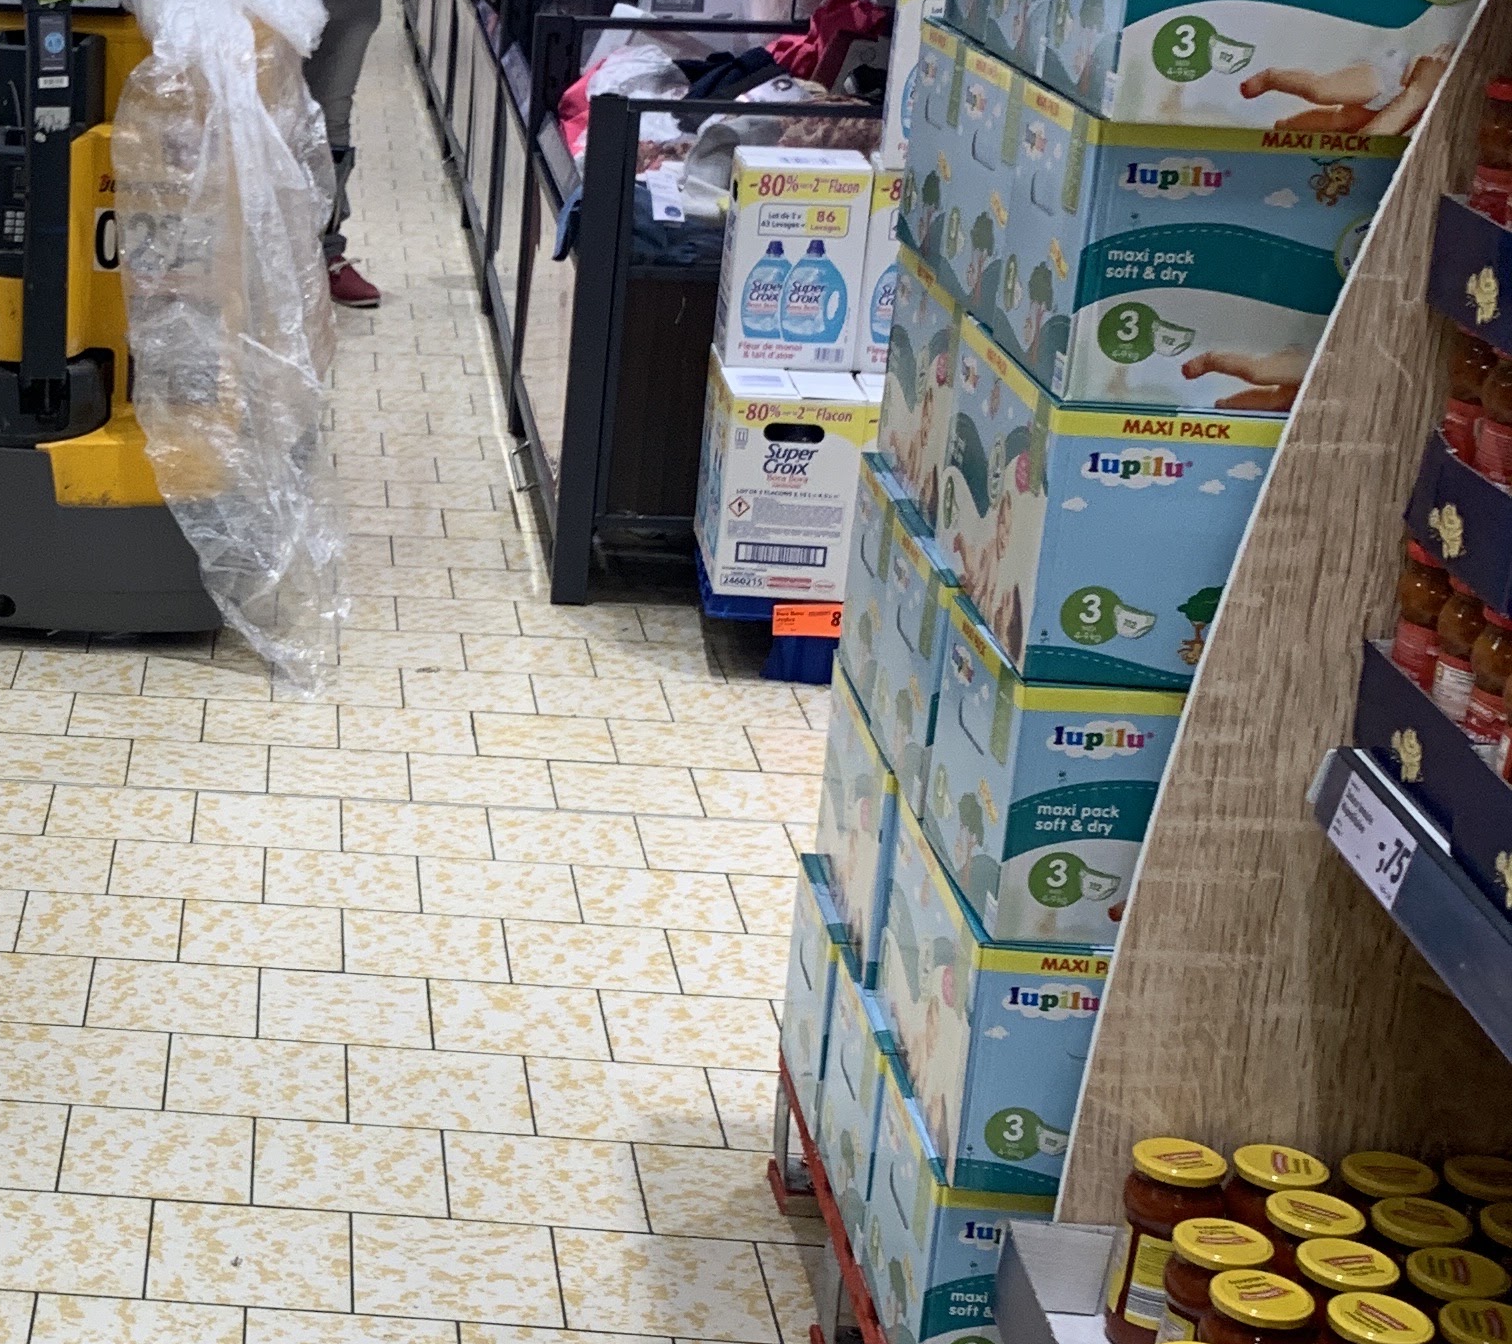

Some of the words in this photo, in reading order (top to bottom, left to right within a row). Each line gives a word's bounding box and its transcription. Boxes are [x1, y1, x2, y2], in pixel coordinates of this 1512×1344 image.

[1171, 24, 1196, 58] 3
[1261, 131, 1312, 148] MAXI
[1319, 133, 1371, 151] PACK
[749, 173, 799, 197] -80%
[828, 179, 860, 194] Flacon
[1126, 162, 1223, 190] lupilu
[816, 211, 836, 222] 86
[1108, 248, 1150, 262] maxi
[1154, 249, 1195, 265] pack
[1105, 265, 1138, 279] soft
[1142, 266, 1156, 280] &
[1160, 267, 1189, 285] dry
[752, 279, 783, 293] Super
[791, 281, 825, 295] Super
[749, 290, 779, 302] Croix
[788, 292, 821, 305] Croix
[1115, 310, 1140, 341] 3
[738, 403, 781, 422] -80%
[816, 408, 853, 423] Flacon
[1123, 419, 1174, 435] MAXI
[1180, 421, 1231, 439] PACK
[764, 443, 819, 462] Super
[762, 458, 809, 476] Croix
[1088, 452, 1183, 480] lupilu
[1079, 594, 1102, 624] 3
[1053, 725, 1145, 751] lupilu
[1037, 803, 1077, 817] maxi
[1081, 805, 1120, 821] pack
[1035, 818, 1067, 832] soft
[1070, 819, 1084, 832] &
[1087, 819, 1113, 836] dry
[1046, 858, 1069, 888] 3
[1041, 957, 1089, 972] MAXI
[1002, 1113, 1025, 1141] 3
[950, 1289, 988, 1303] maxi
[948, 1304, 977, 1317] soft
